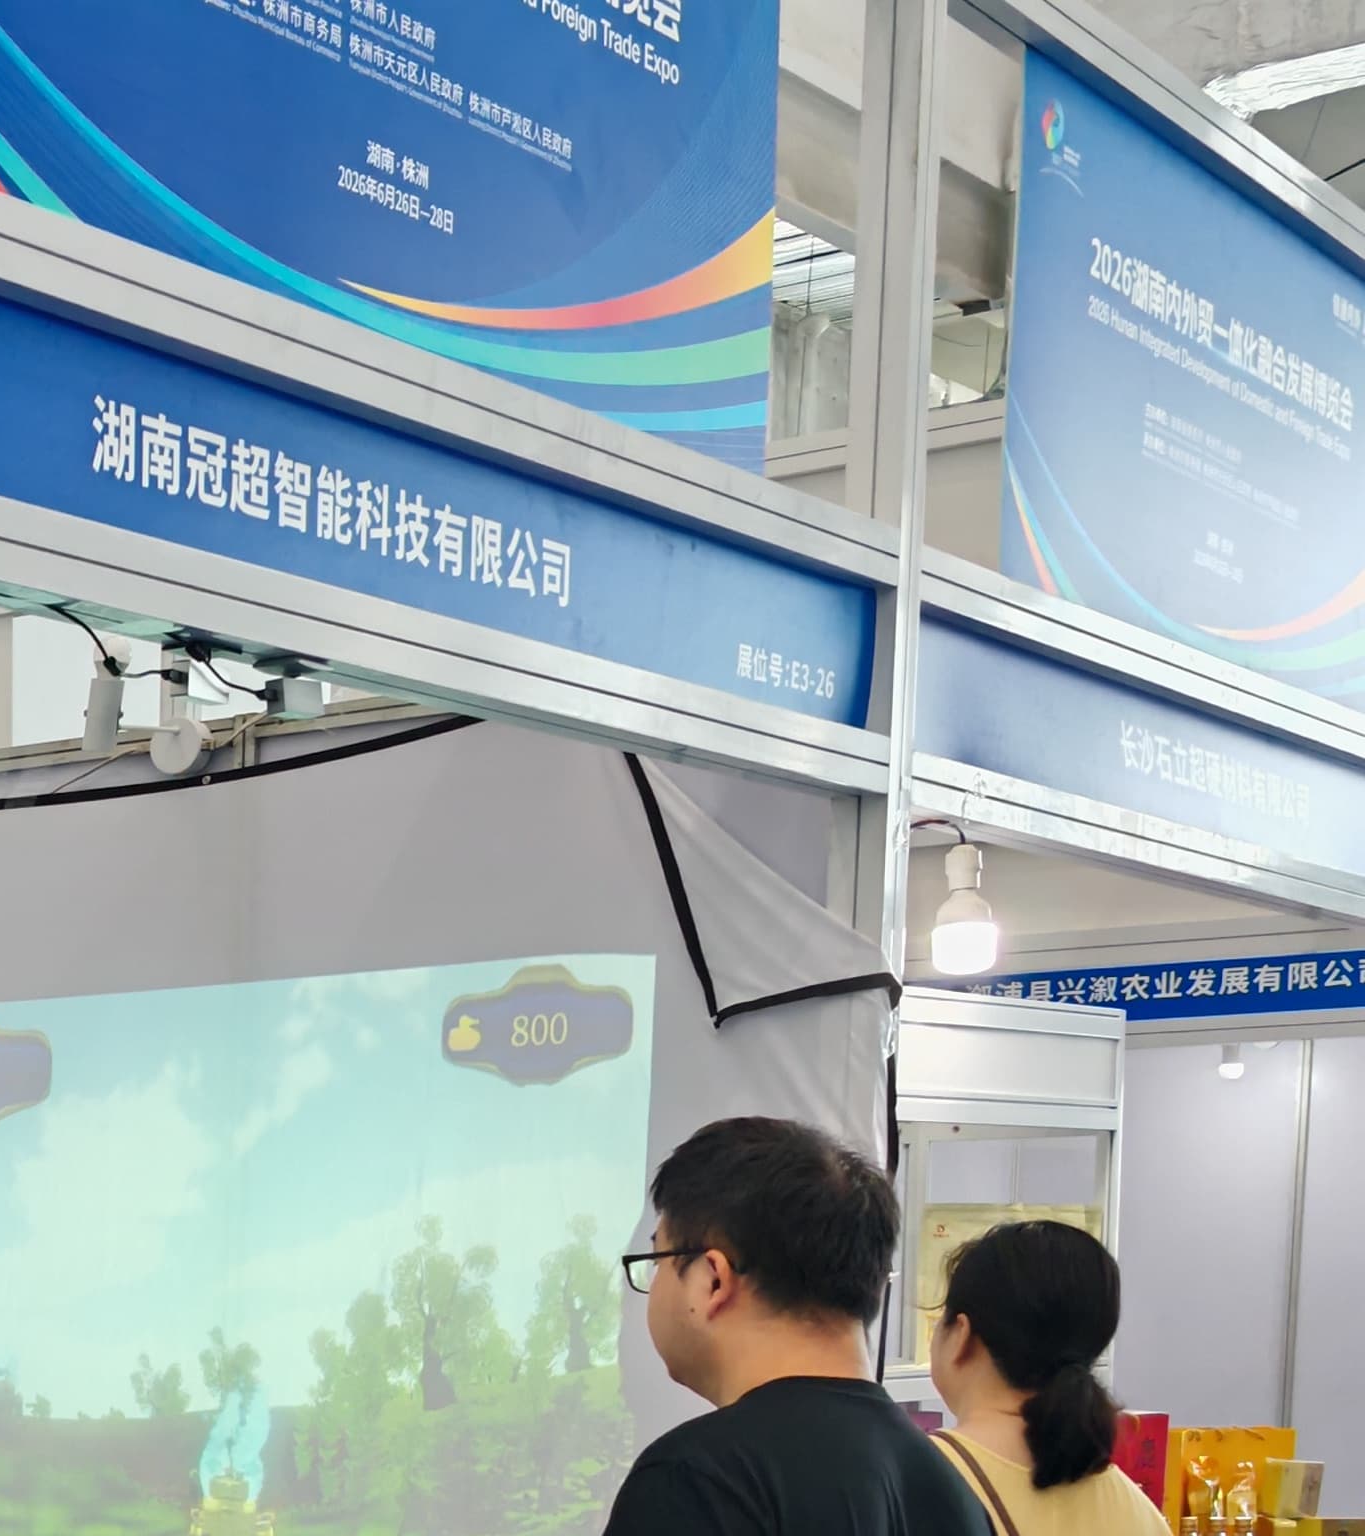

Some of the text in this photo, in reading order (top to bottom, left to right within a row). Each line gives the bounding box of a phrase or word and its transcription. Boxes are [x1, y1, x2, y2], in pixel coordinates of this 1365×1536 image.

[263, 0, 341, 48] 株洲市商务局
[349, 32, 463, 107] 株洲市天元区人民政府
[469, 90, 573, 159] 株洲市芦淞区人民政府
[600, 19, 640, 64] Trade
[644, 43, 679, 85] Expo
[366, 139, 429, 191] 湖南·株洲
[1089, 238, 1354, 432] 2026湖南内外贸一体化融合发展博览会
[92, 395, 571, 608] 湖南冠超智能科技有限公司
[736, 643, 836, 700] 展位号:E3-26
[511, 1012, 568, 1048] 800
